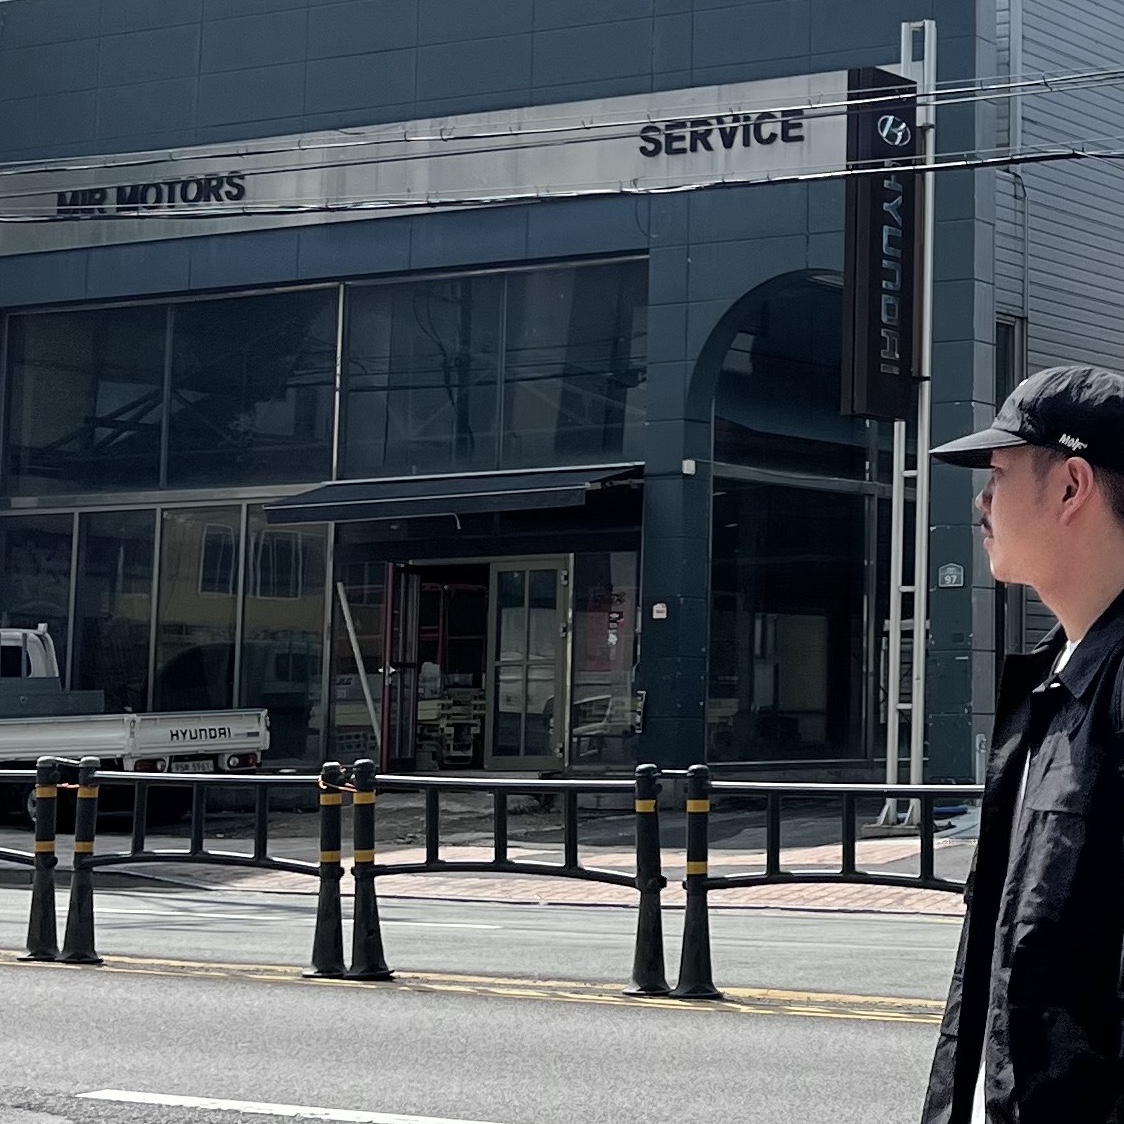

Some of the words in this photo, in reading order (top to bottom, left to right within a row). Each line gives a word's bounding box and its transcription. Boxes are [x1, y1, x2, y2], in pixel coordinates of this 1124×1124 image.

[638, 108, 805, 158] SERVICE
[56, 186, 108, 215] MIR
[115, 170, 247, 213] MOTORS
[880, 159, 903, 375] HYUNDAI
[170, 727, 232, 741] HYUNDAI
